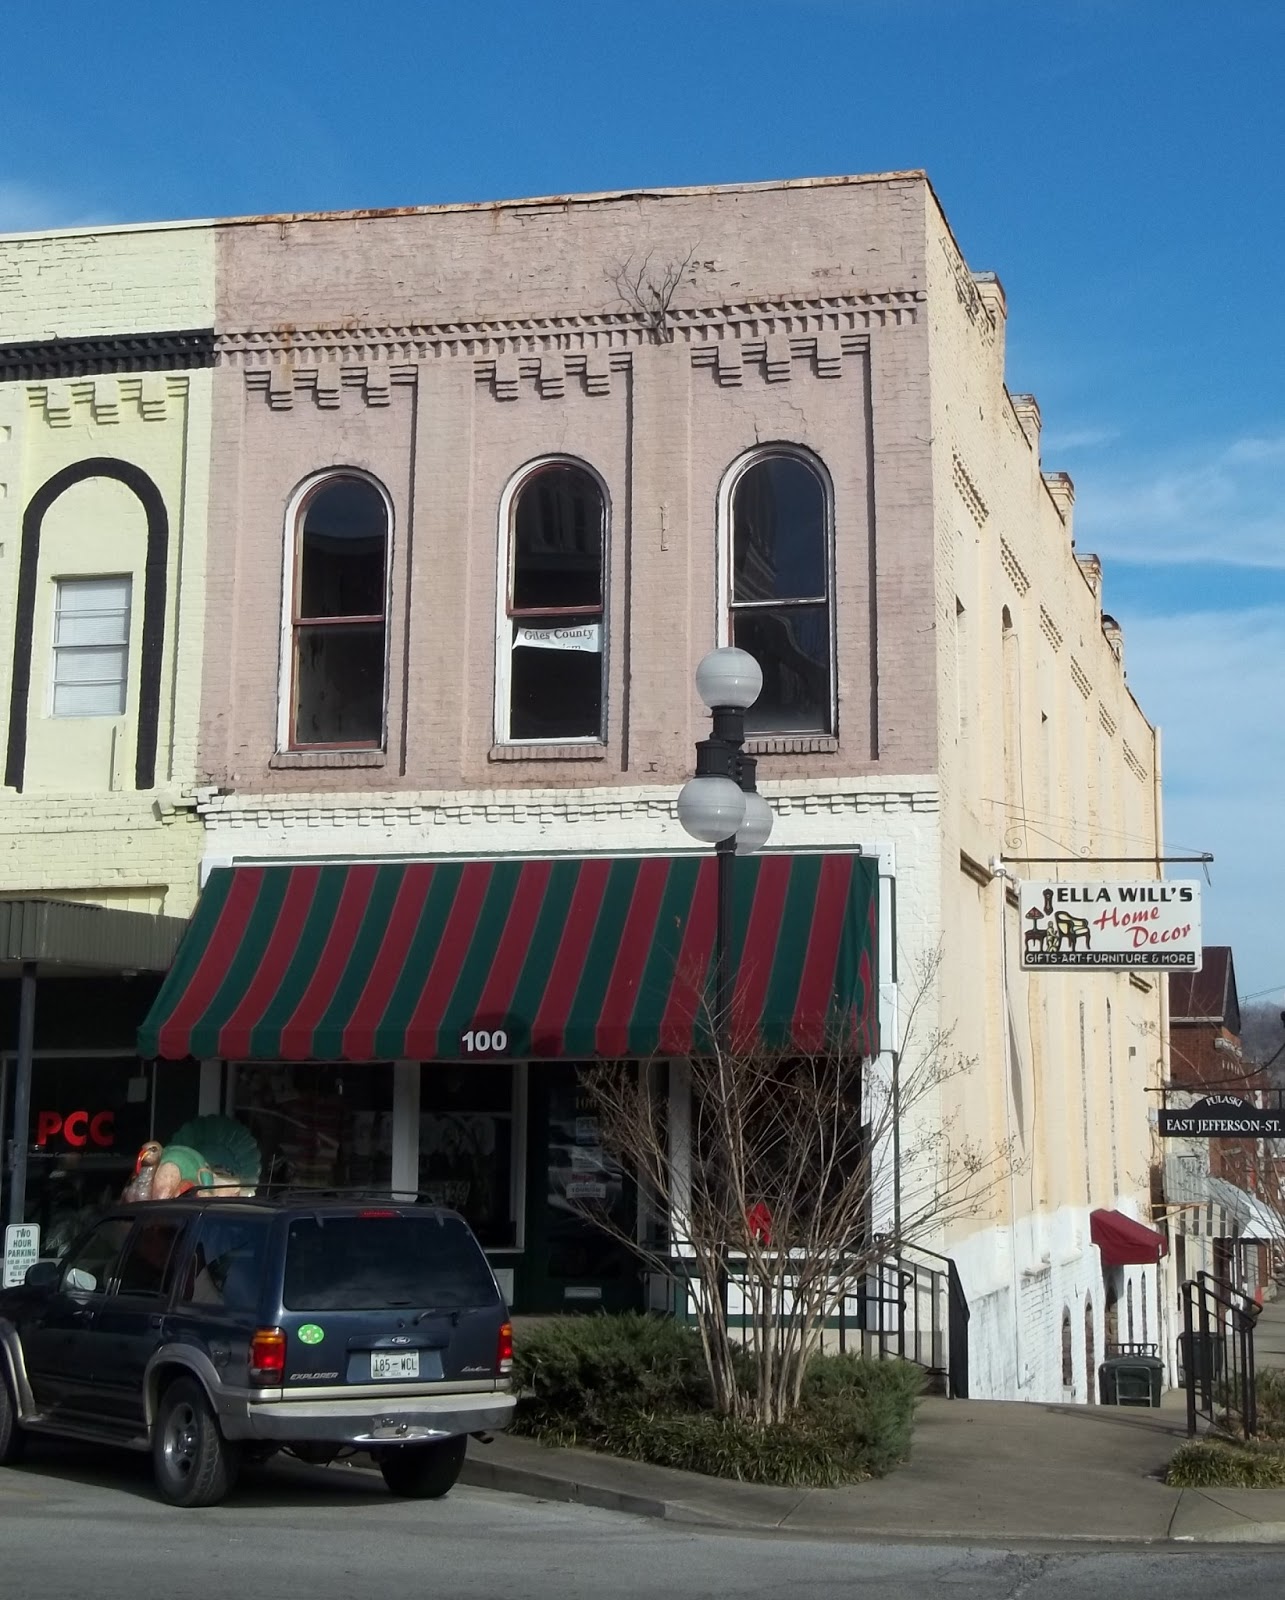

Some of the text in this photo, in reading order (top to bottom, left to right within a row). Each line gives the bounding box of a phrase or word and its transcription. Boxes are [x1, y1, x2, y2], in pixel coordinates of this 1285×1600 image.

[524, 629, 594, 640] Giles County
[1057, 887, 1193, 902] ELLA WILL'S
[1092, 906, 1160, 931] Home
[1125, 923, 1191, 948] Decor
[1152, 953, 1159, 963] &
[1162, 953, 1194, 963] MORE
[462, 1030, 507, 1052] 100
[1206, 1095, 1243, 1108] PULASKI
[37, 1111, 114, 1147] PCC
[1167, 1119, 1195, 1131] EAST
[16, 1229, 31, 1238] TWO
[13, 1239, 32, 1248] HOUR
[8, 1248, 36, 1258] PARKING
[289, 1372, 339, 1380] EXPLORER
